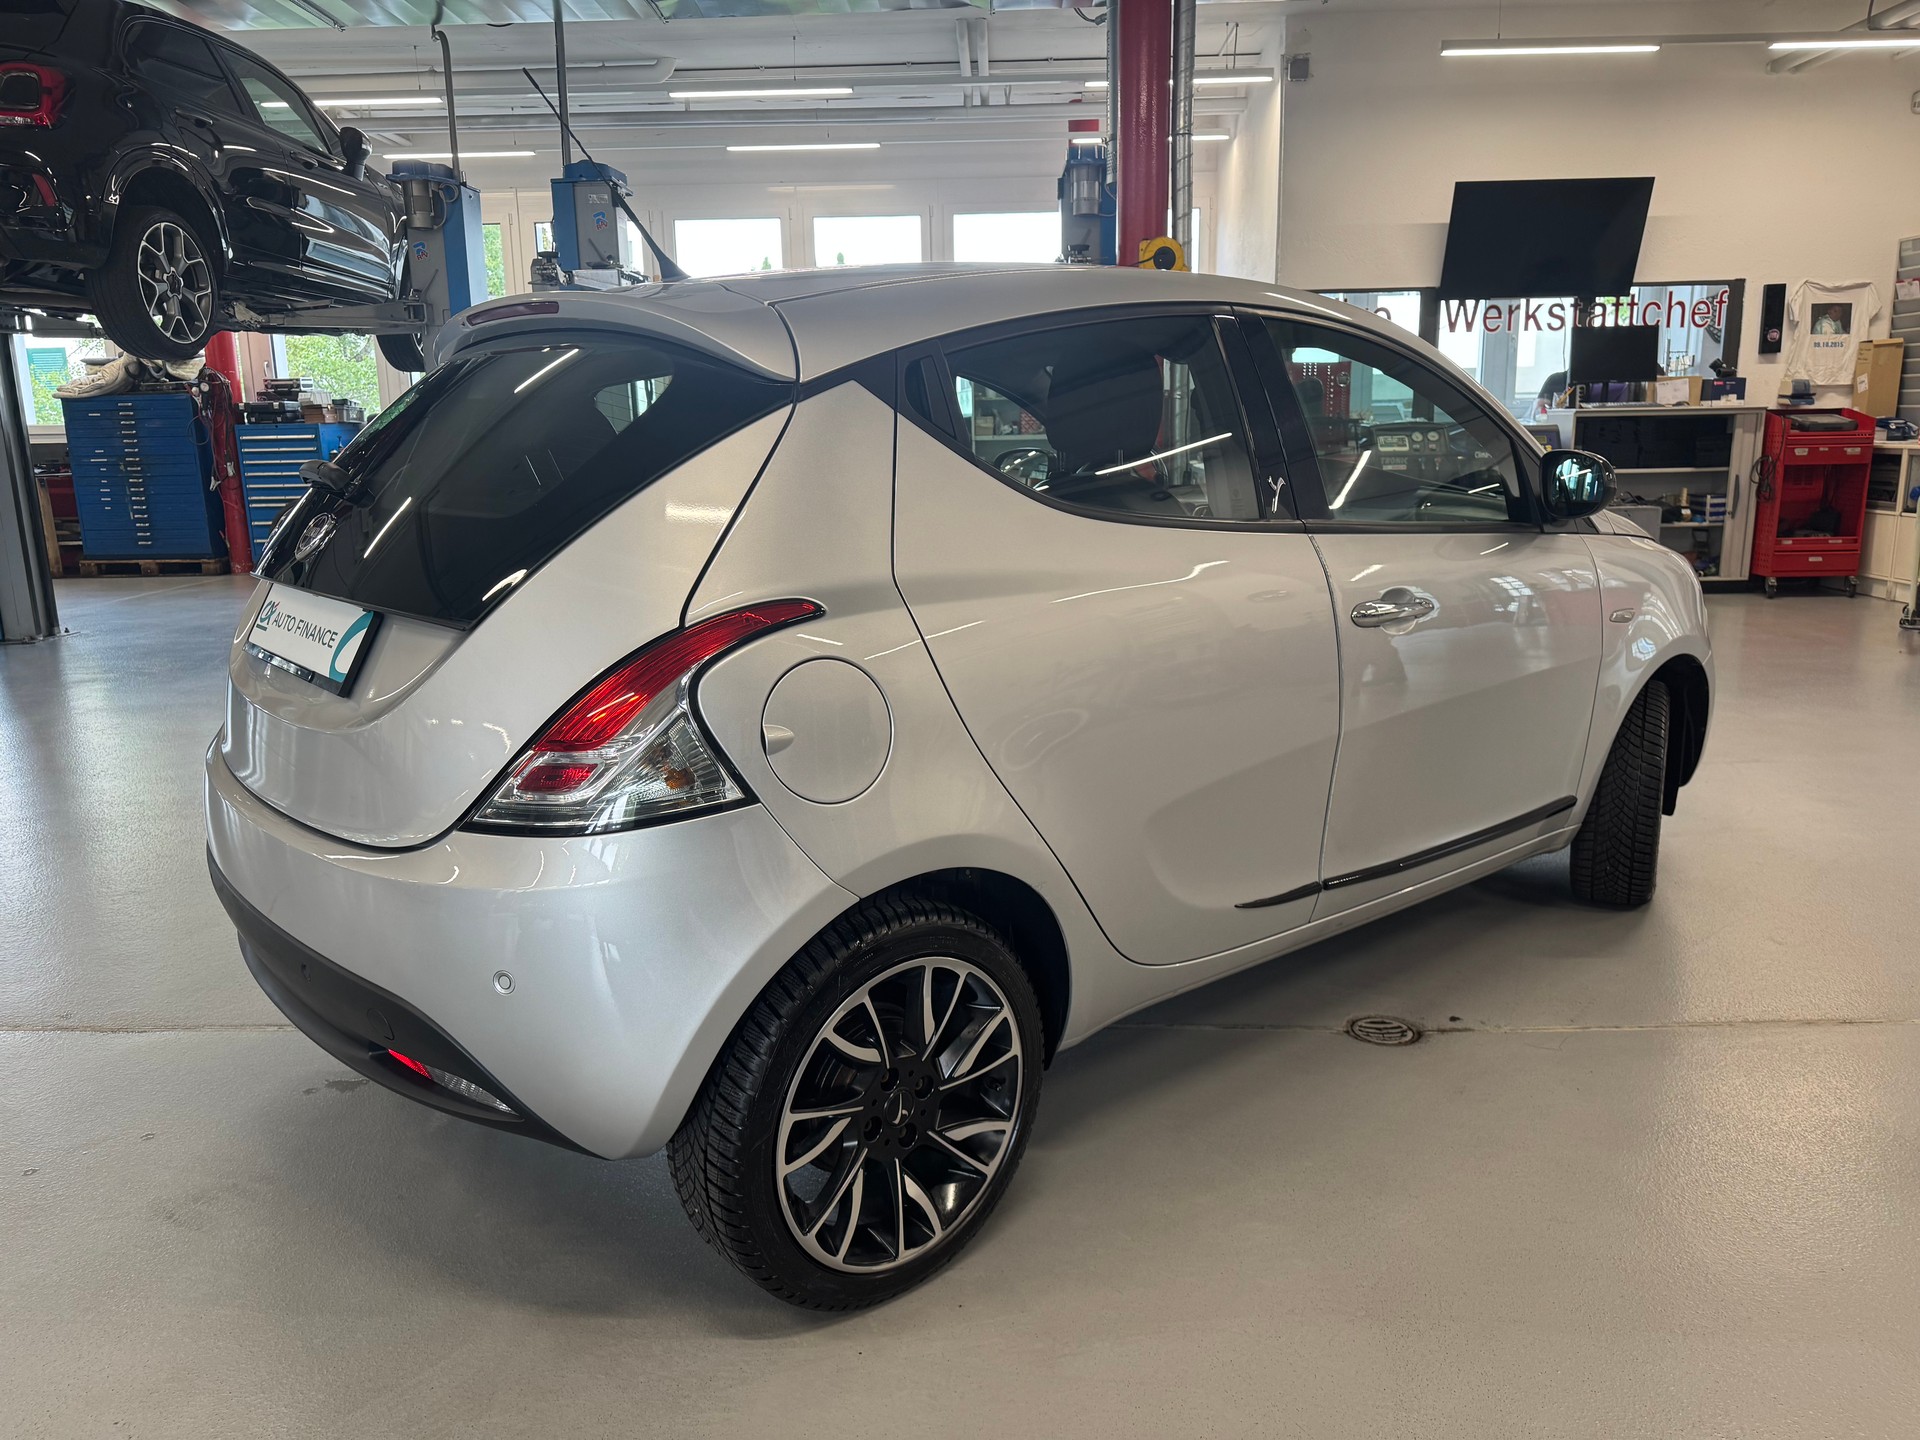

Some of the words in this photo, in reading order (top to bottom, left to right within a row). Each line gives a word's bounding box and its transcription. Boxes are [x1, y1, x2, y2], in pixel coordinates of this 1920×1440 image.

[1447, 290, 1729, 332] Werkstattchef
[272, 612, 296, 632] AUTO
[294, 620, 338, 648] FINANCE
